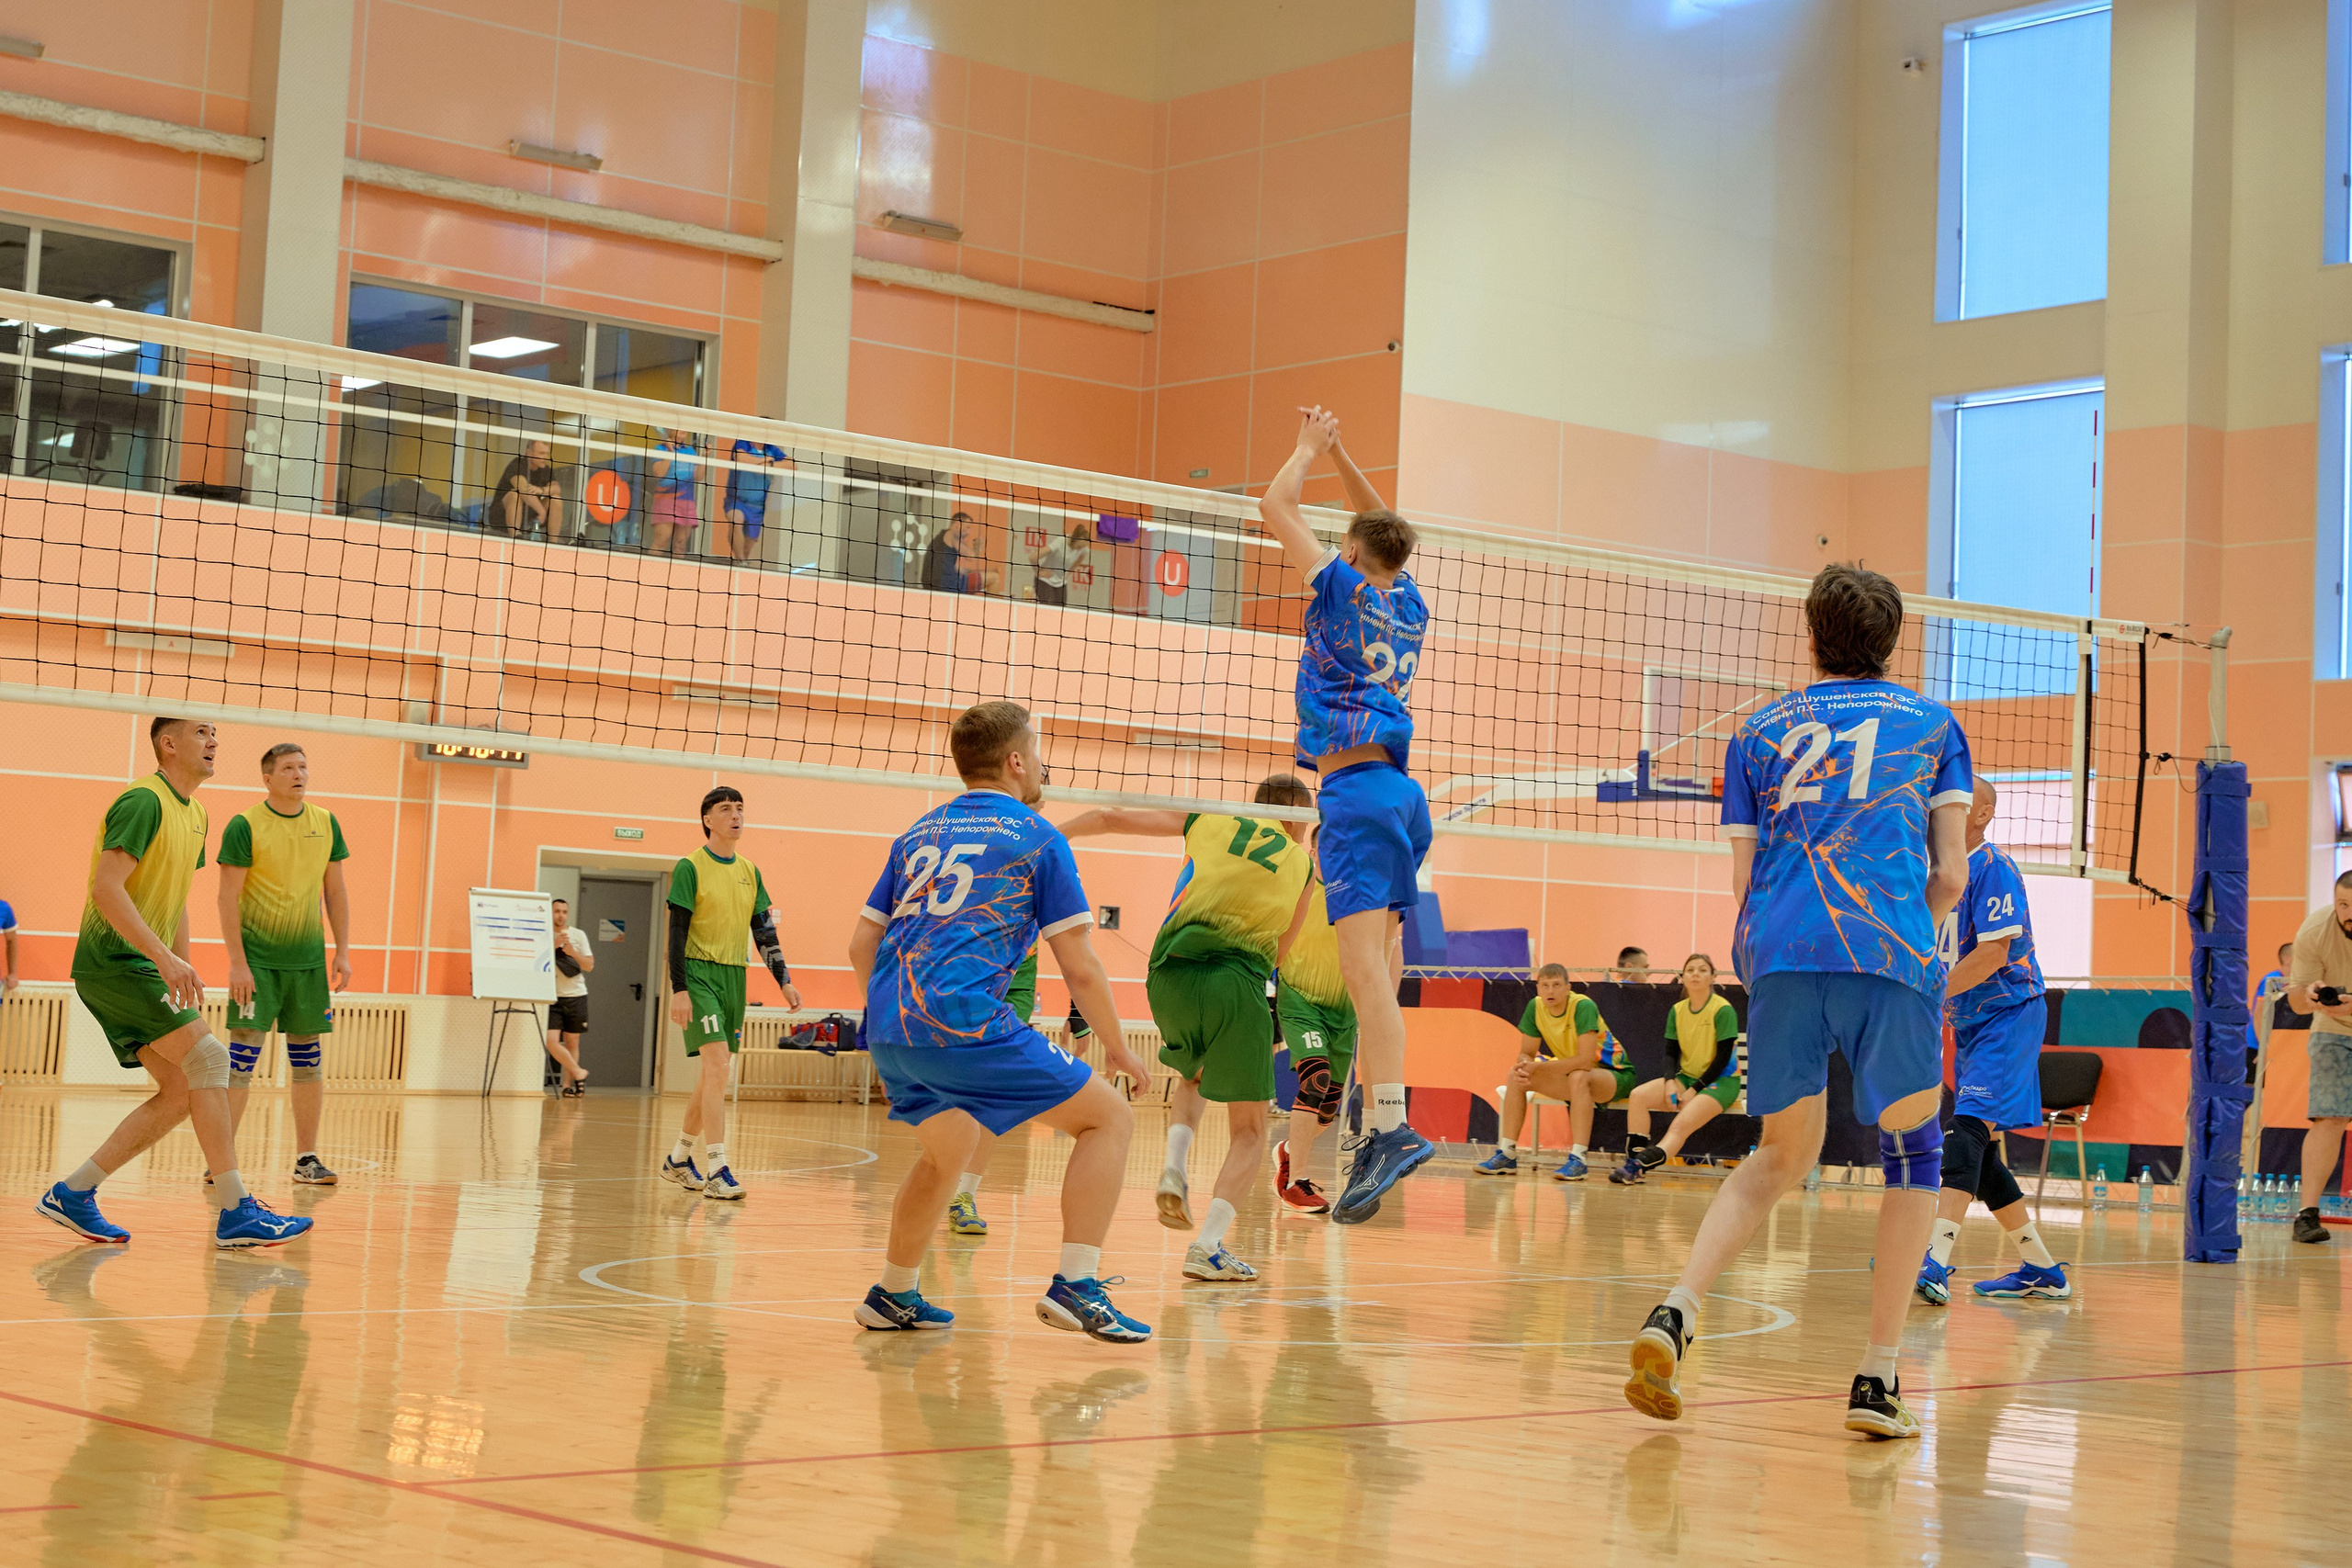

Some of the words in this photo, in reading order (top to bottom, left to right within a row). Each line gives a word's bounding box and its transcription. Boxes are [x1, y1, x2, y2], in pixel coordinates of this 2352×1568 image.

[1362, 642, 1418, 706] 22
[1753, 692, 1886, 724] Саяно-Шушенская
[1890, 692, 1917, 705] ГЭС
[1756, 710, 1793, 731] имени
[1797, 704, 1824, 714] П.С.
[1828, 700, 1924, 716] Непорожнего
[1780, 718, 1880, 811] 21
[930, 826, 949, 834] П.С.
[950, 825, 1022, 840] Непорожнего
[998, 817, 1023, 828] ГЭС
[1227, 816, 1287, 874] 12
[892, 844, 988, 919] 25
[1987, 893, 2015, 922] 24
[1935, 911, 1959, 972] 4
[700, 1014, 719, 1034] 11
[1302, 1031, 1324, 1049] 15
